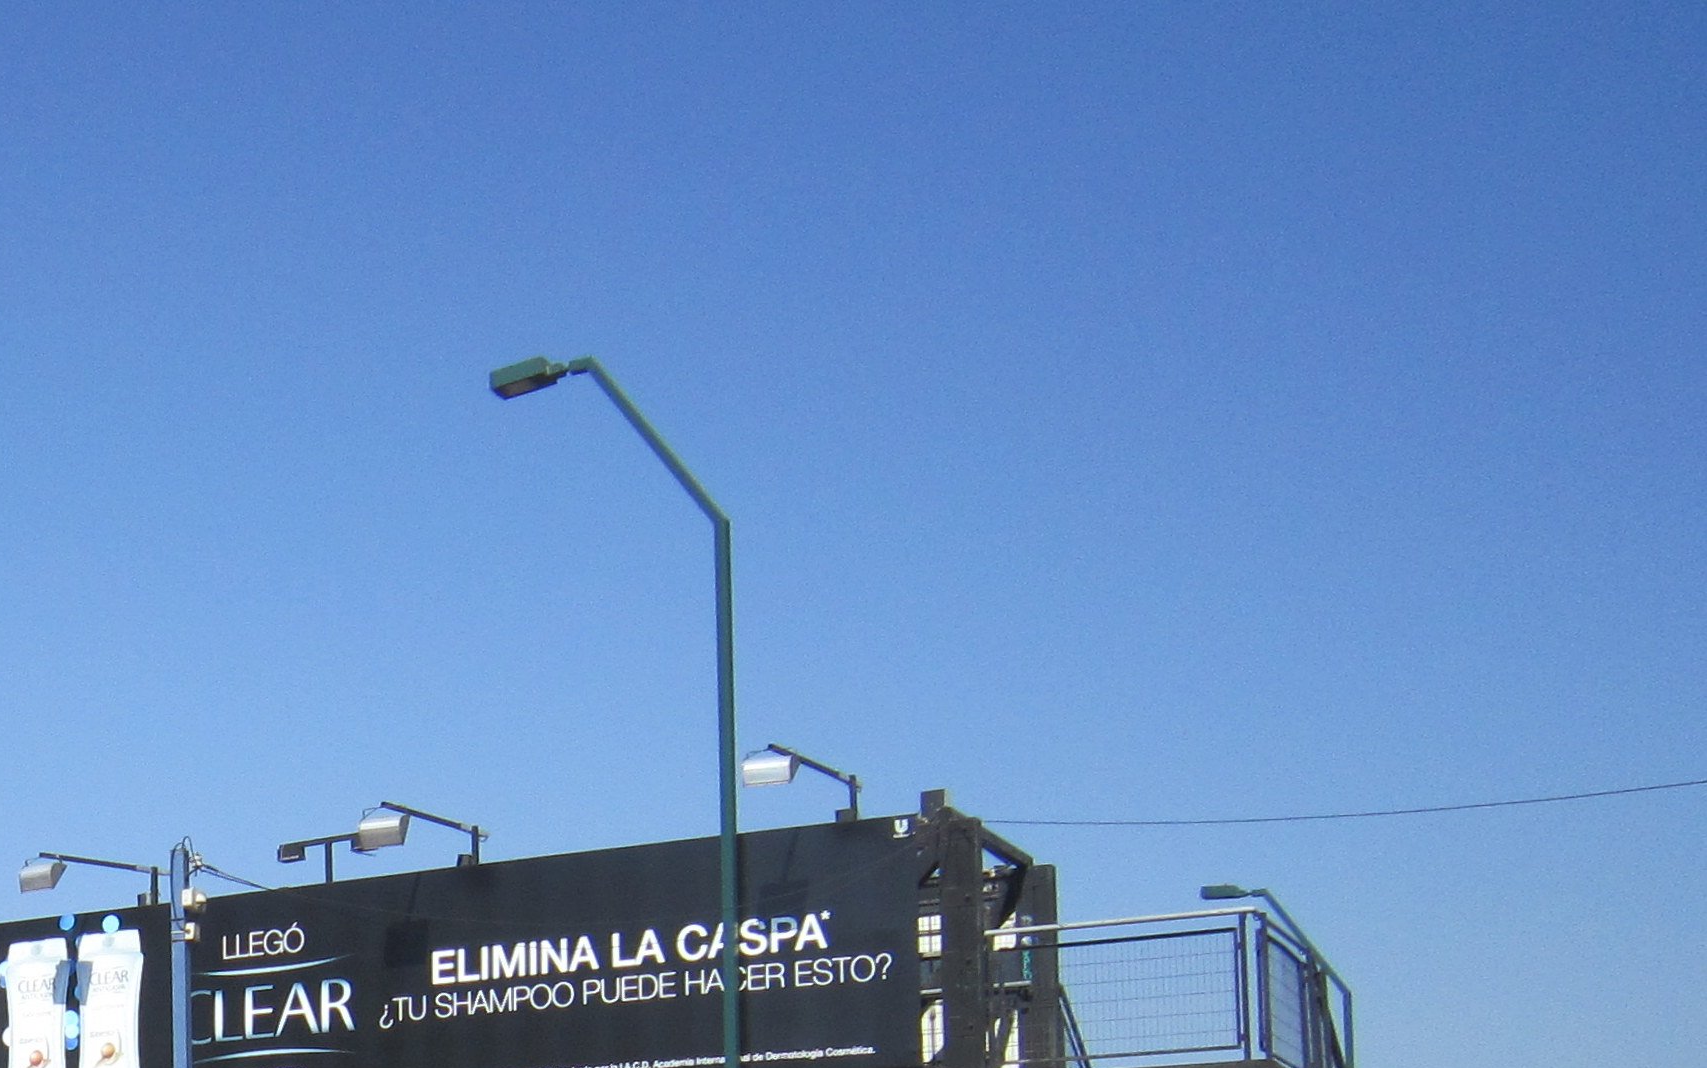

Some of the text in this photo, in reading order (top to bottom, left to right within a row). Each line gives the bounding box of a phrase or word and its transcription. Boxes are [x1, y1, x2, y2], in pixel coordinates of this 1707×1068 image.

[222, 921, 305, 960] LLEGÓ
[432, 934, 600, 985] ELIMINA
[611, 929, 666, 968] LA
[91, 970, 128, 986] CLEAR
[379, 995, 427, 1030] ¿TU
[434, 981, 574, 1019] SHAMPOO
[583, 971, 676, 1005] PUEDE
[794, 952, 892, 988] ESTO?
[653, 1058, 694, 1068] Academia
[752, 1053, 763, 1062] de
[765, 1049, 824, 1061] Dermatología
